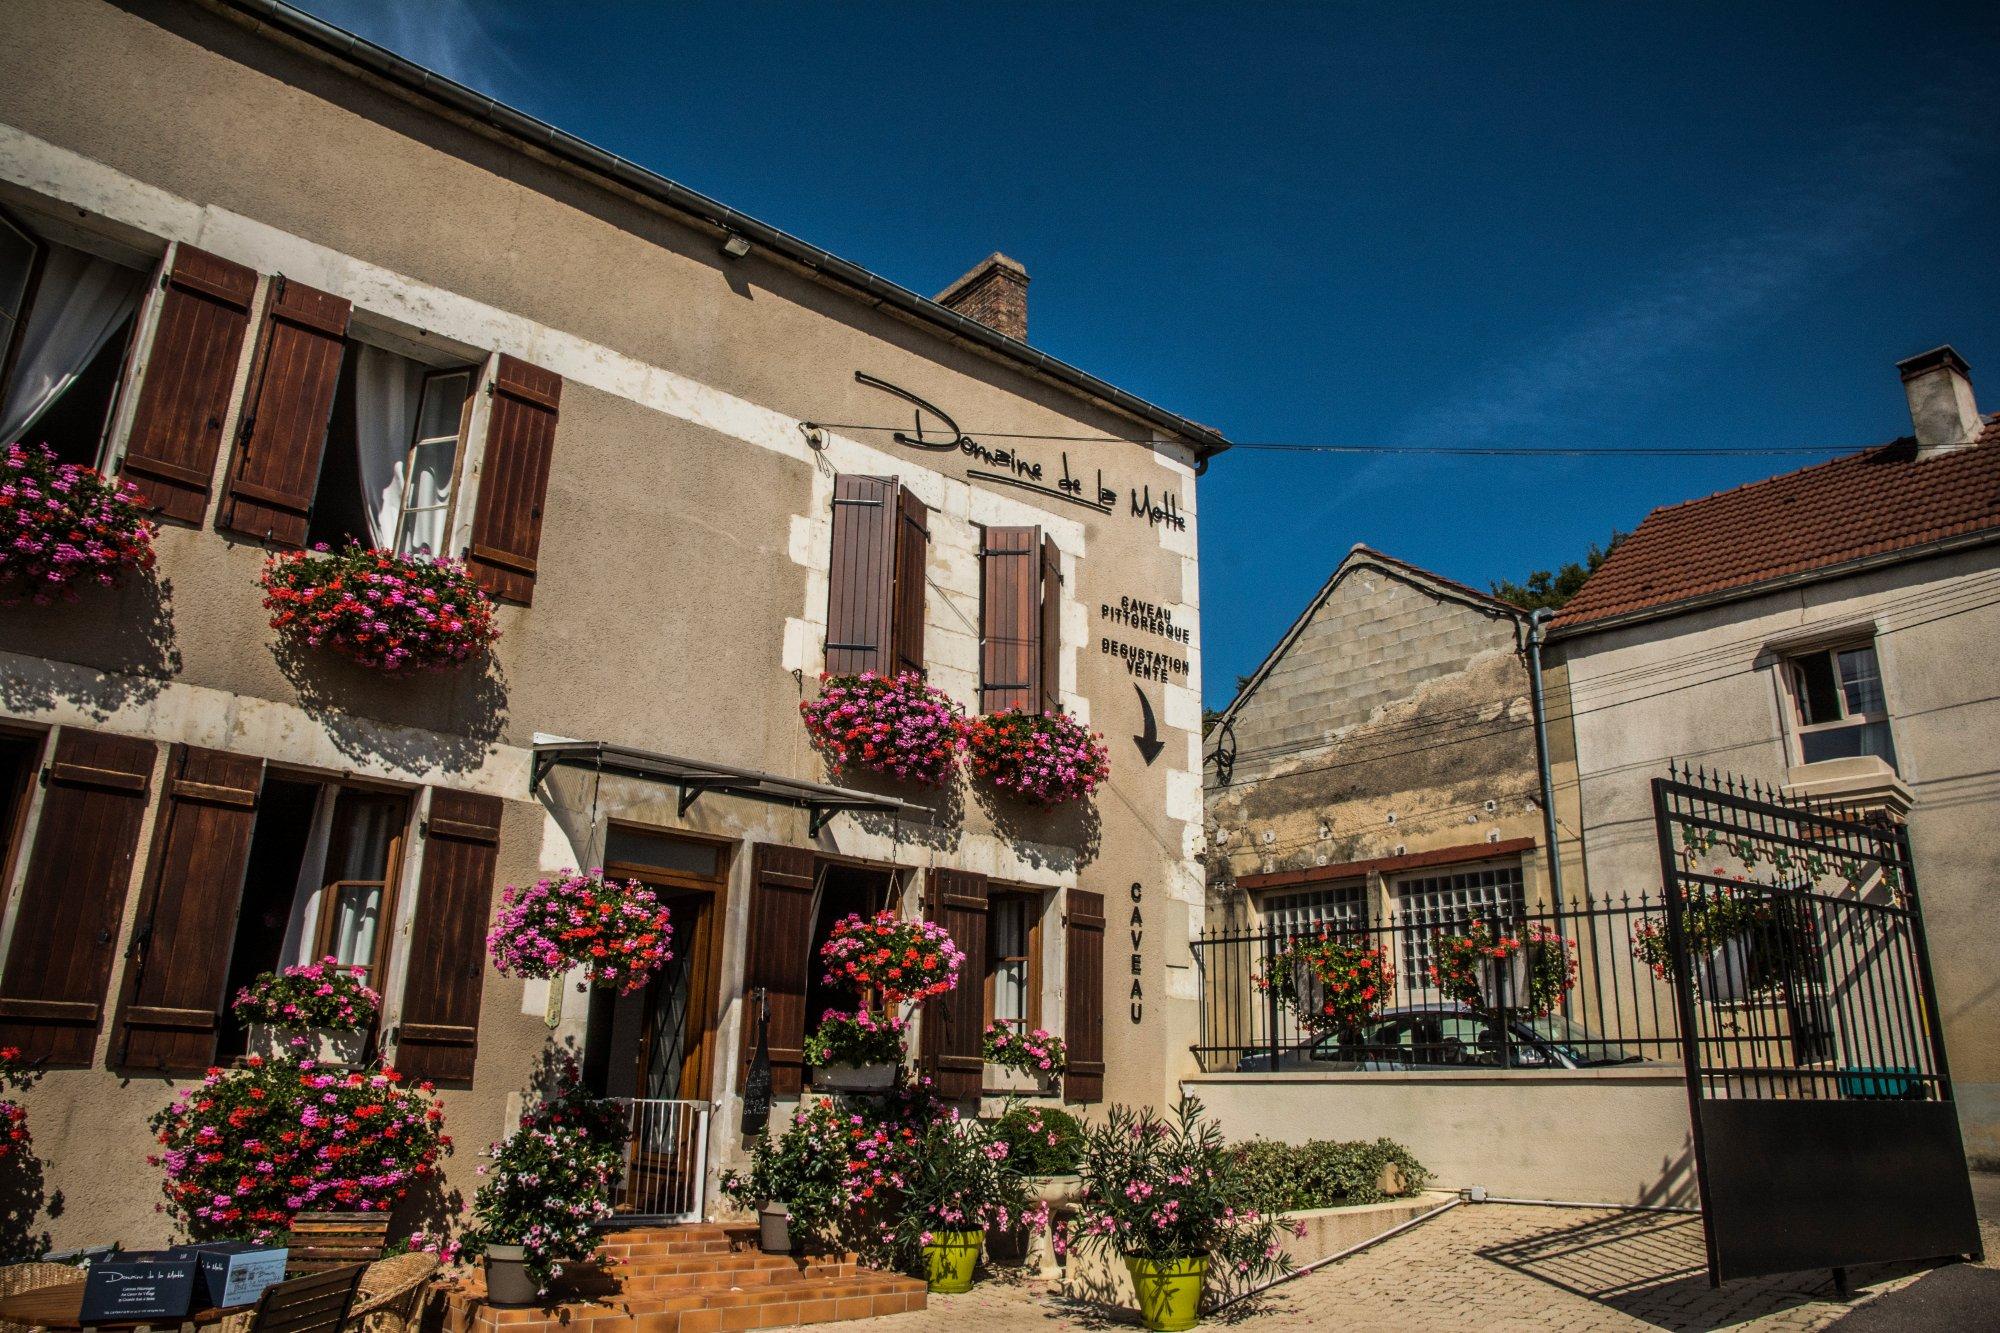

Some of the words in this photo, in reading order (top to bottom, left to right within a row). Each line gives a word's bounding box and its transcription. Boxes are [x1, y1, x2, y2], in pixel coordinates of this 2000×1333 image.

[855, 371, 1042, 481] Domaine
[1058, 452, 1082, 495] de
[1098, 469, 1117, 505] la
[1131, 485, 1186, 532] Motte
[1101, 604, 1189, 644] PITTORESQUE
[1121, 596, 1171, 624] CAVEAU
[1101, 638, 1189, 676] DEGUSTATION
[1126, 659, 1168, 684] VENTE
[1130, 882, 1143, 1024] CAVEAU
